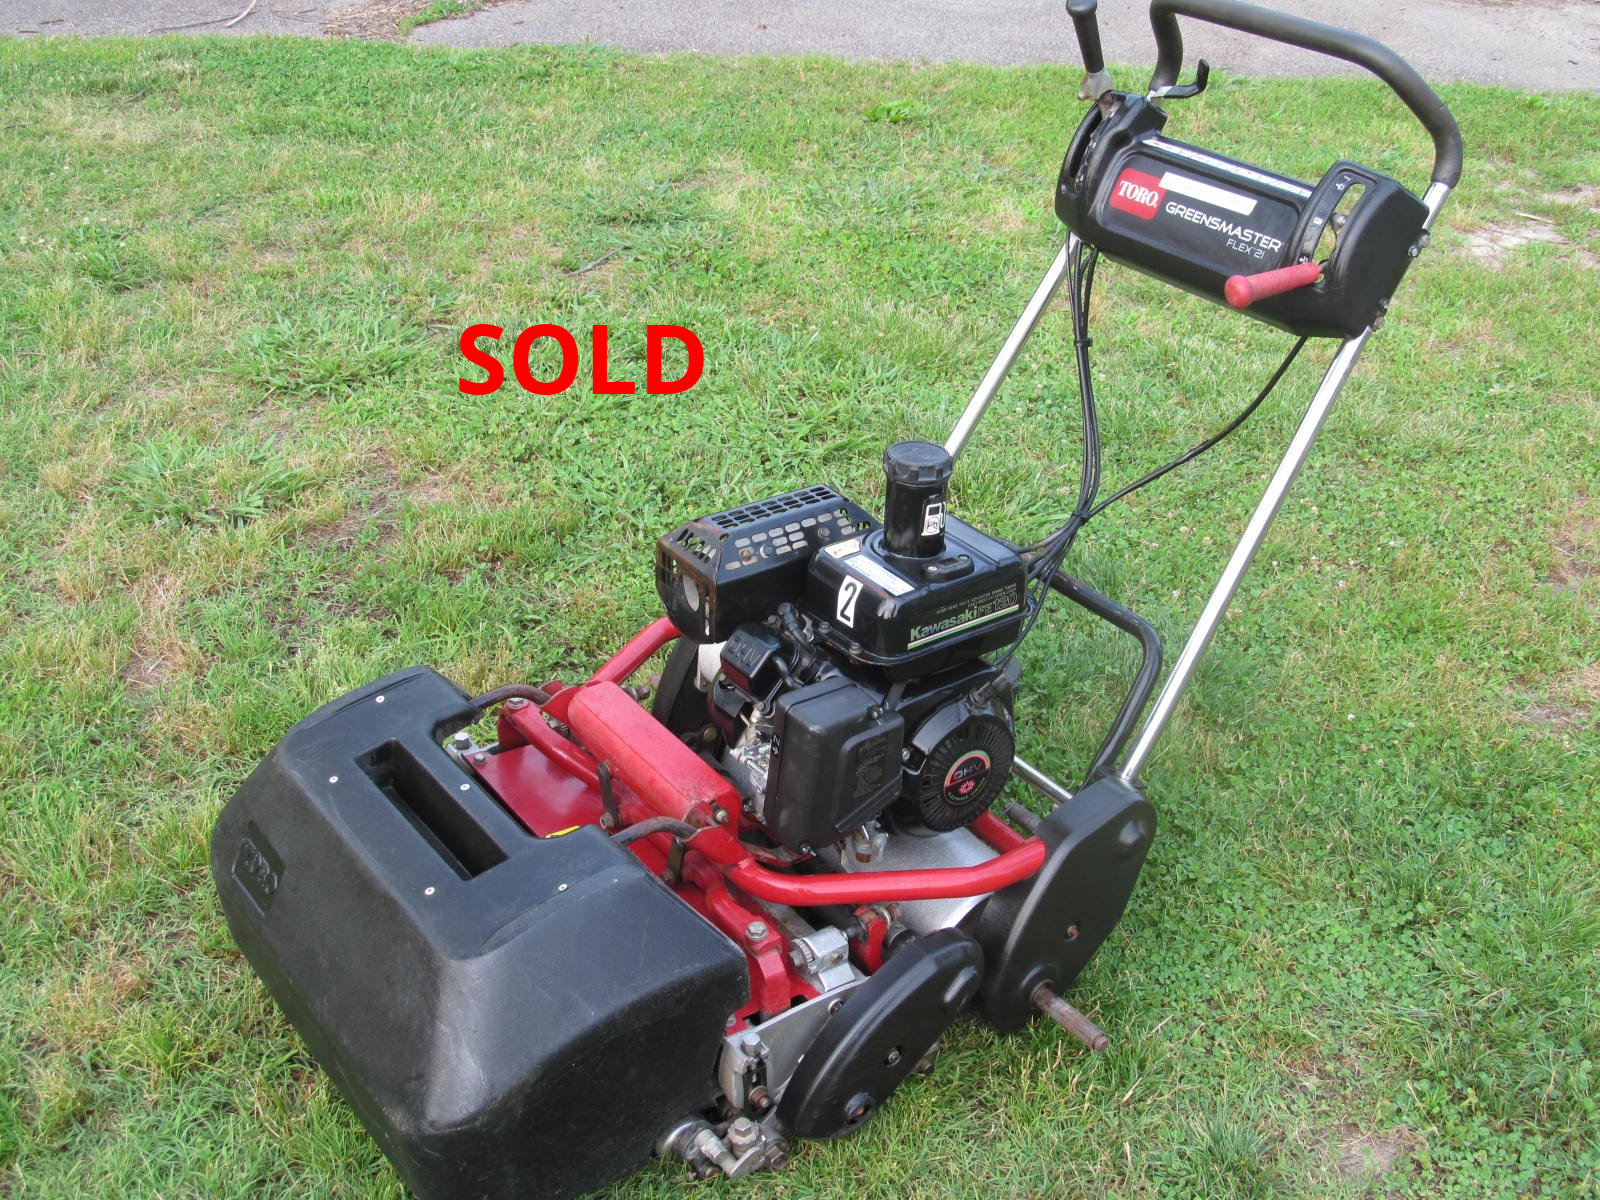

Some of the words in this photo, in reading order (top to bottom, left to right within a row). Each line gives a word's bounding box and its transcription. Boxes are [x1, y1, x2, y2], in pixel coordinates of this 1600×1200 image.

[1118, 181, 1158, 207] TORO
[1166, 202, 1282, 252] GREENSMASTER
[1226, 239, 1251, 255] FLEX
[840, 582, 857, 622] 2
[910, 605, 977, 641] Kawasaki
[954, 761, 983, 779] OHV
